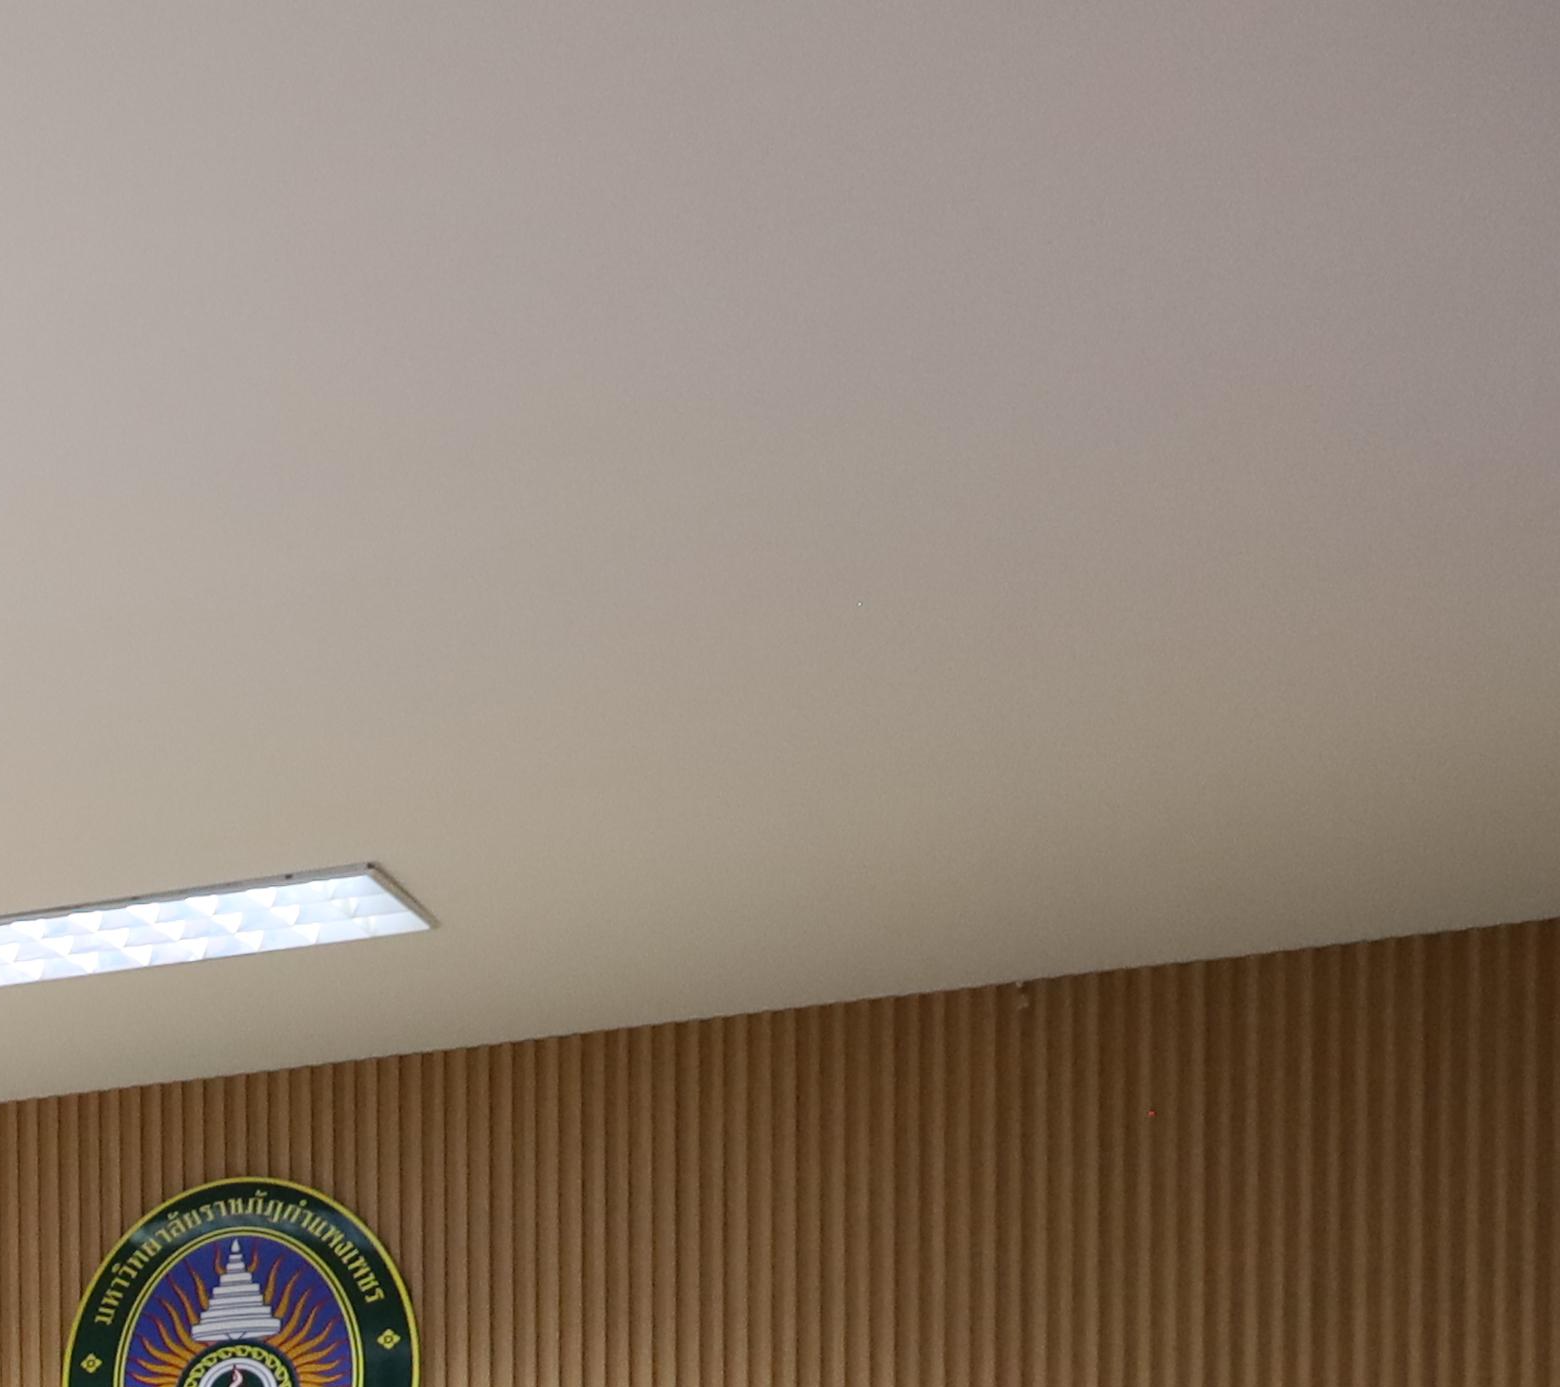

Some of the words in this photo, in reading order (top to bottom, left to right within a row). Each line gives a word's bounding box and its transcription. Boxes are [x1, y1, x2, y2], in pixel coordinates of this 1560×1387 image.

[95, 1190, 385, 1326] มหาวิทยาลัยราชภัฏกำแพงเพชร
